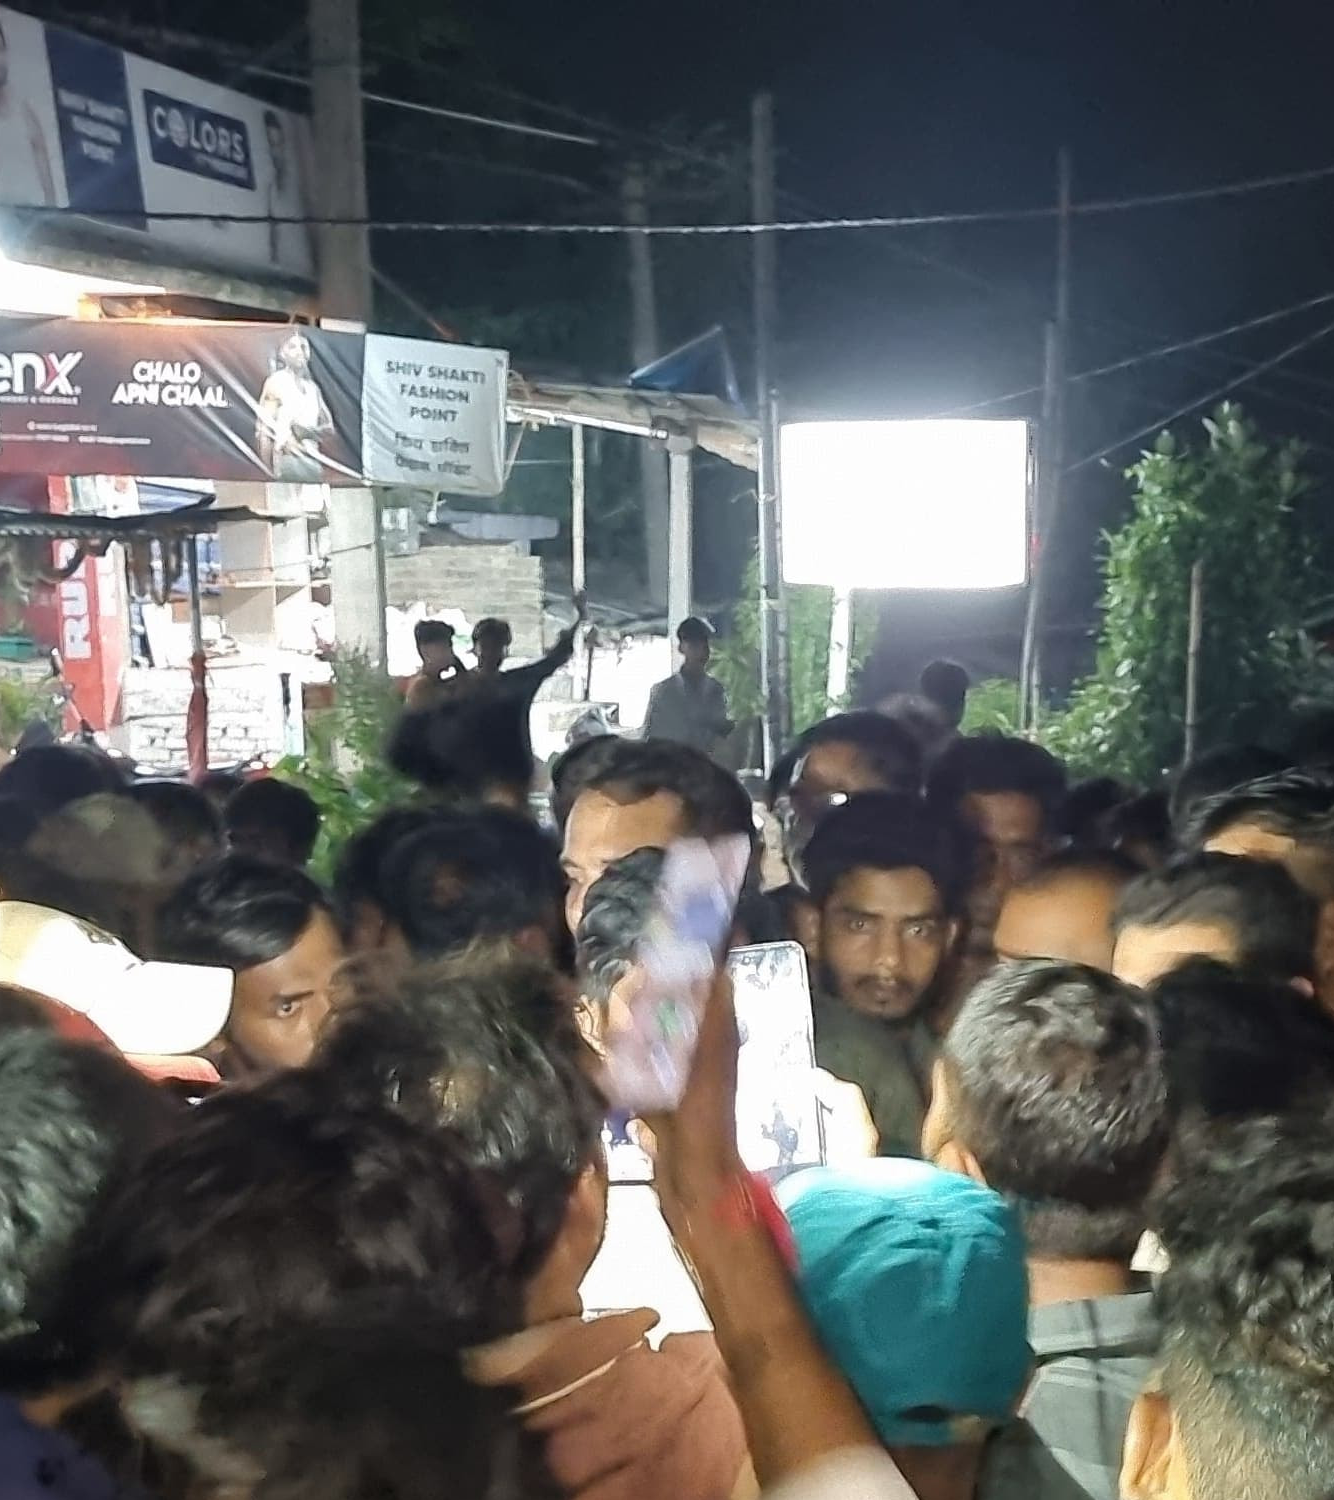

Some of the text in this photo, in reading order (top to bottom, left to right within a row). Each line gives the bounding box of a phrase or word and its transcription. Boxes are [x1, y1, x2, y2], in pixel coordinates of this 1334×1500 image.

[153, 105, 246, 164] COLORS
[132, 360, 202, 383] CHALO
[385, 360, 487, 385] SHIV SHAKTI
[111, 383, 229, 408] APNI CHAAL
[400, 383, 471, 404] FASHION
[410, 406, 459, 422] POINT
